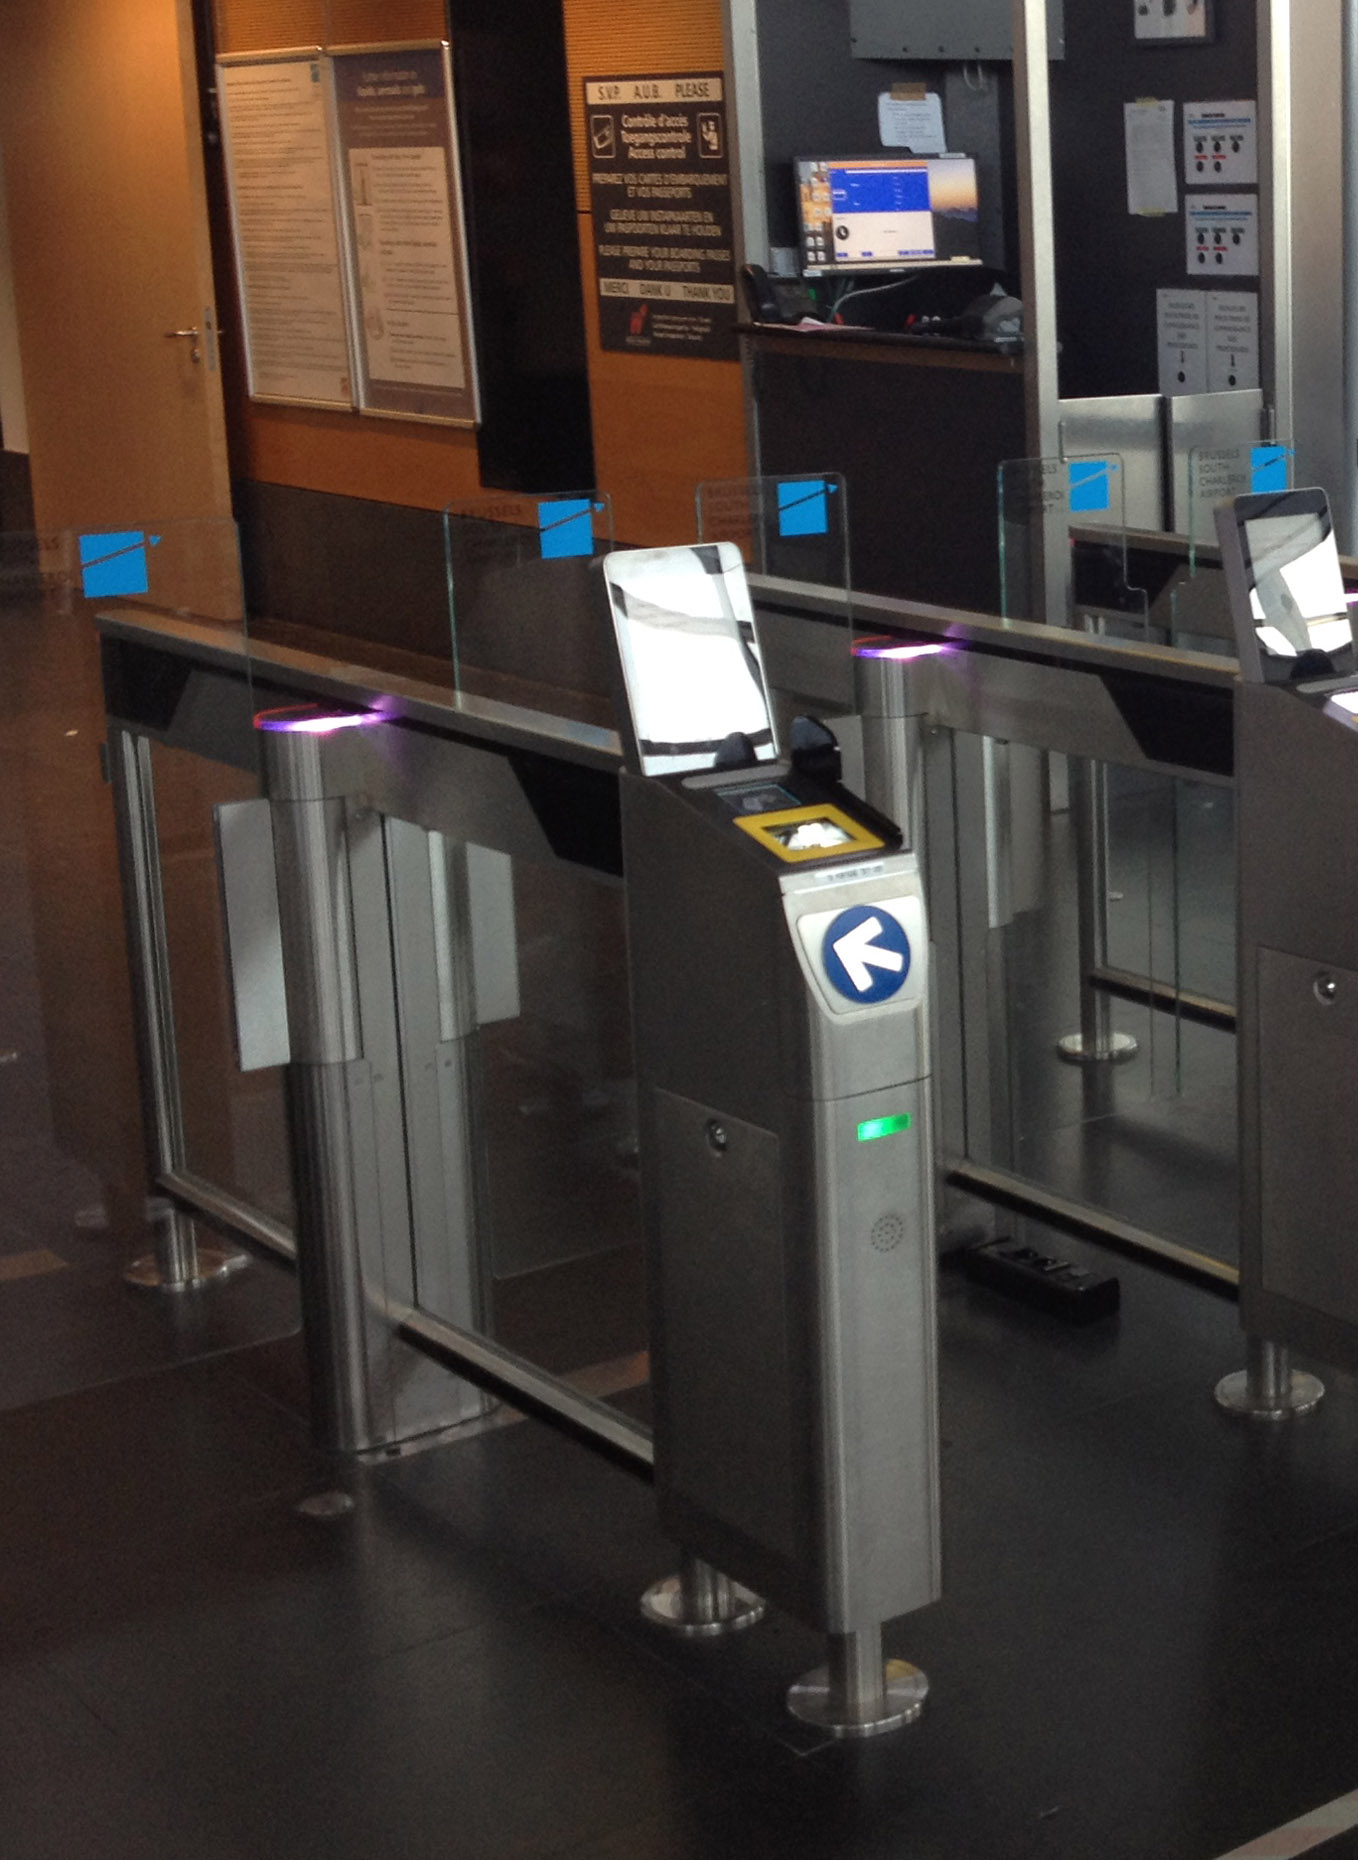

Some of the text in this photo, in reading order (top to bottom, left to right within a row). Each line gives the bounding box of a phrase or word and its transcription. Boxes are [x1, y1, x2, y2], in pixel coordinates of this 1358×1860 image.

[598, 82, 710, 100] S.V.P. A.U.B. PLEASE
[621, 113, 689, 128] Contrôle d'accès
[620, 130, 692, 147] Toegangscontrole
[628, 146, 686, 159] Access control
[624, 173, 638, 185] VOS
[638, 173, 662, 185] CARTES
[627, 186, 636, 197] ET
[637, 186, 651, 198] VOS
[650, 247, 669, 258] YOUR
[644, 260, 662, 271] YOUR
[604, 281, 629, 294] MERCI
[639, 283, 663, 296] DANK
[682, 285, 710, 299] THANK
[711, 287, 731, 300] YOU
[1199, 462, 1230, 474] SOUTH
